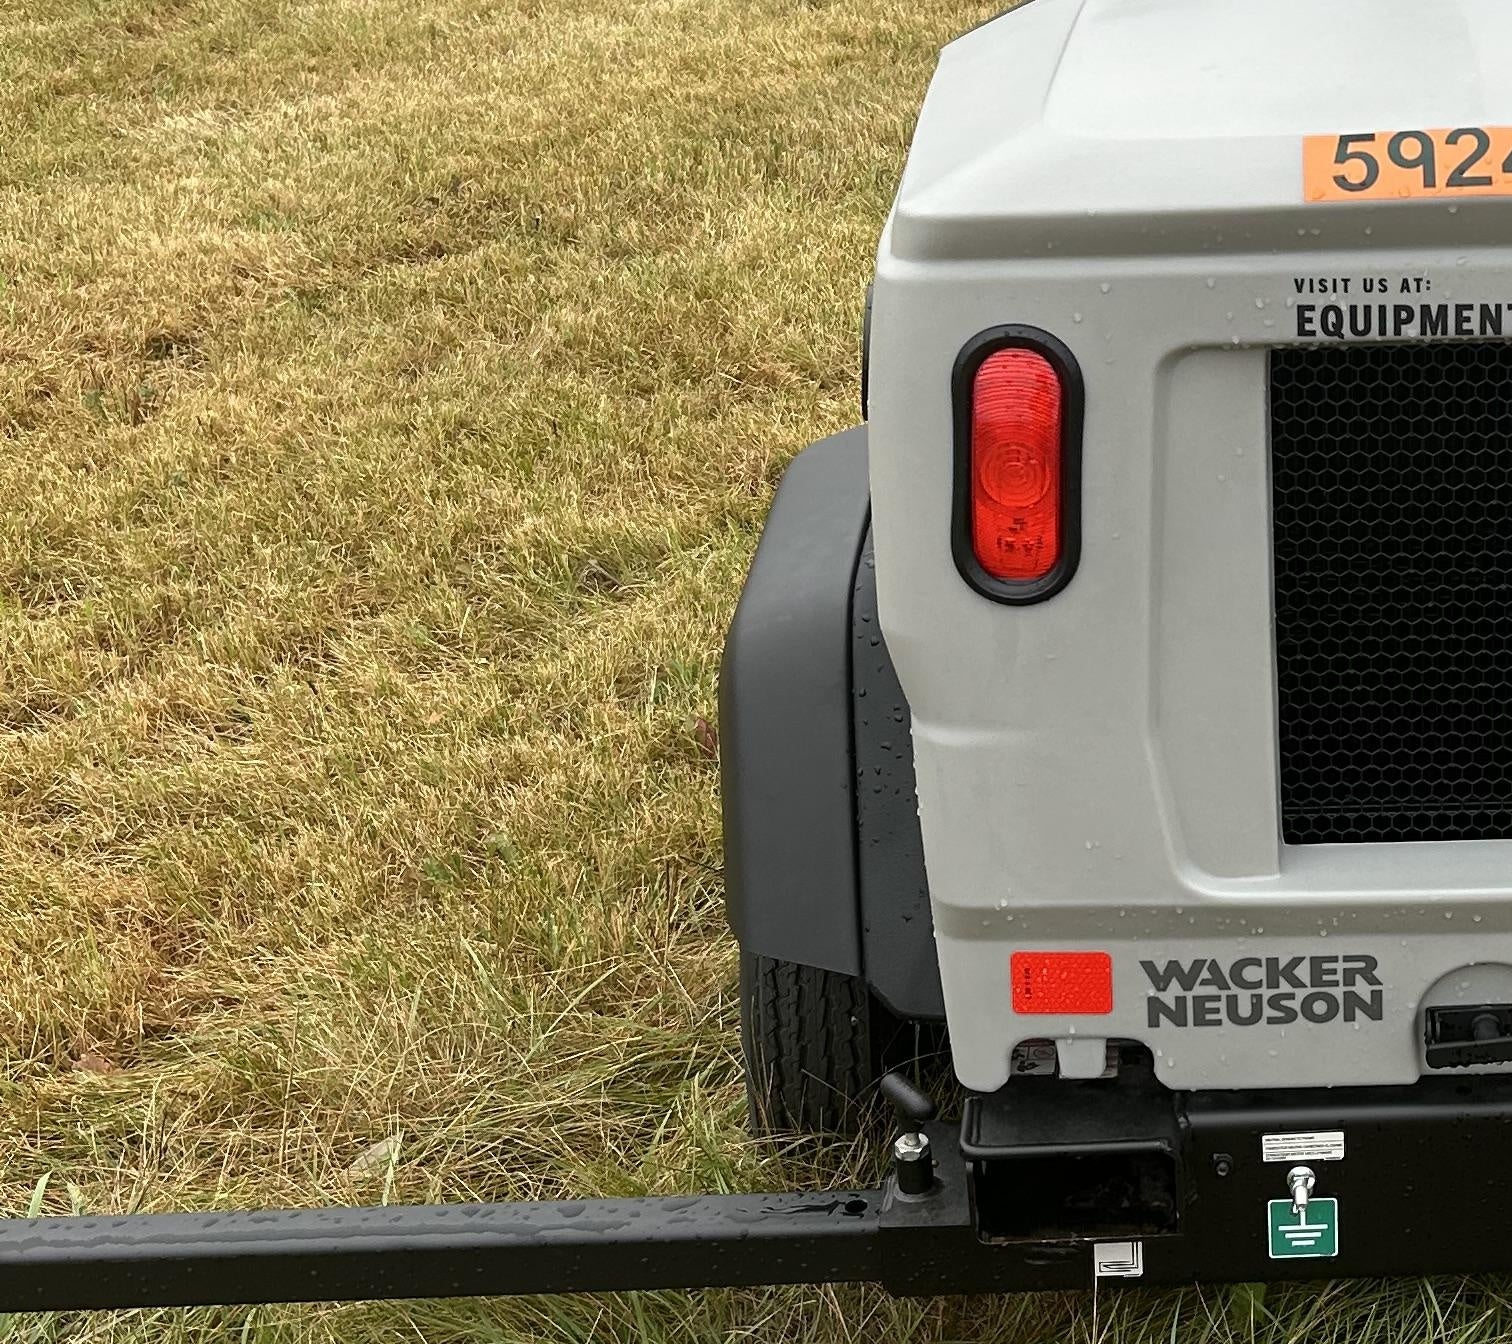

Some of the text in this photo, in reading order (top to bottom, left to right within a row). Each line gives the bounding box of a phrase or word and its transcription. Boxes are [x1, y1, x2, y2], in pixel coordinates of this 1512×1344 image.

[1294, 277, 1431, 294] VISIT US AT:
[1138, 954, 1384, 992] WACKER
[1147, 989, 1383, 1028] NEUSON
